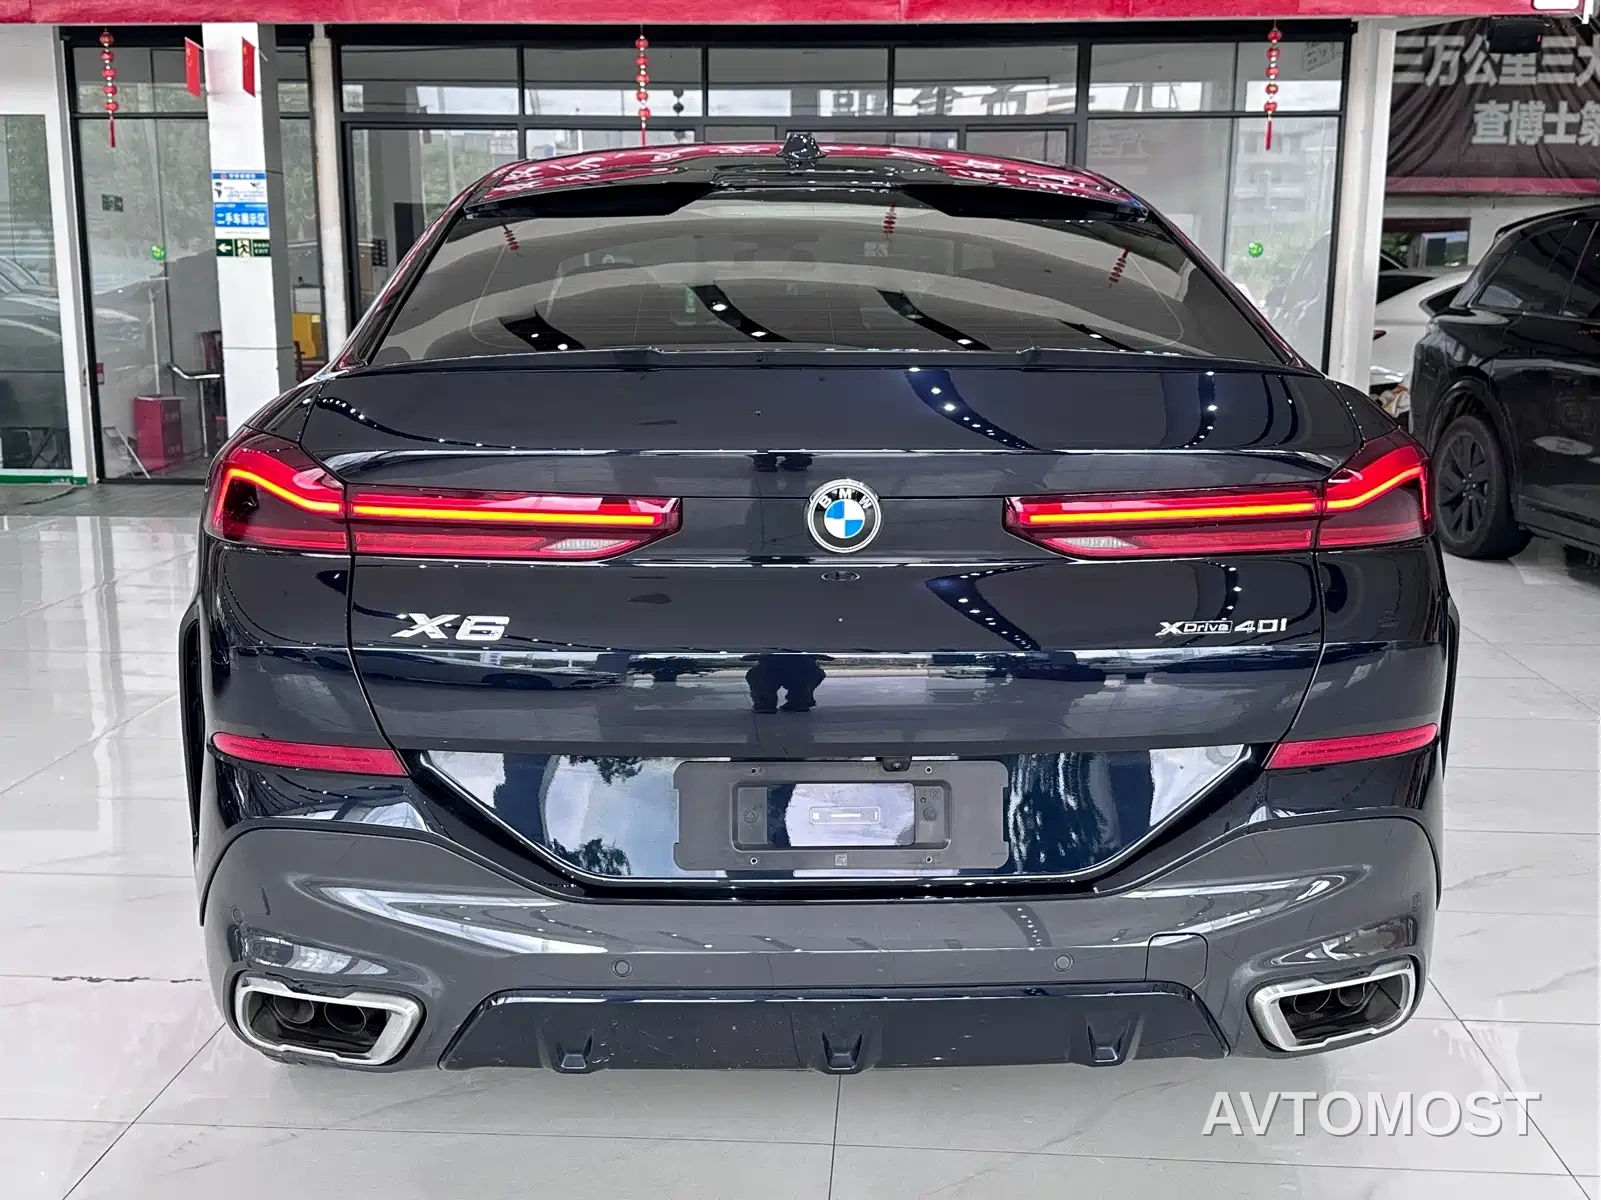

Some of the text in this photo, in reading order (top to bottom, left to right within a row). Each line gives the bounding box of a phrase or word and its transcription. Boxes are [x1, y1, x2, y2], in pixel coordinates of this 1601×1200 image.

[1471, 99, 1600, 146] 查博士第
[818, 488, 872, 510] BMW
[390, 612, 510, 641] X6
